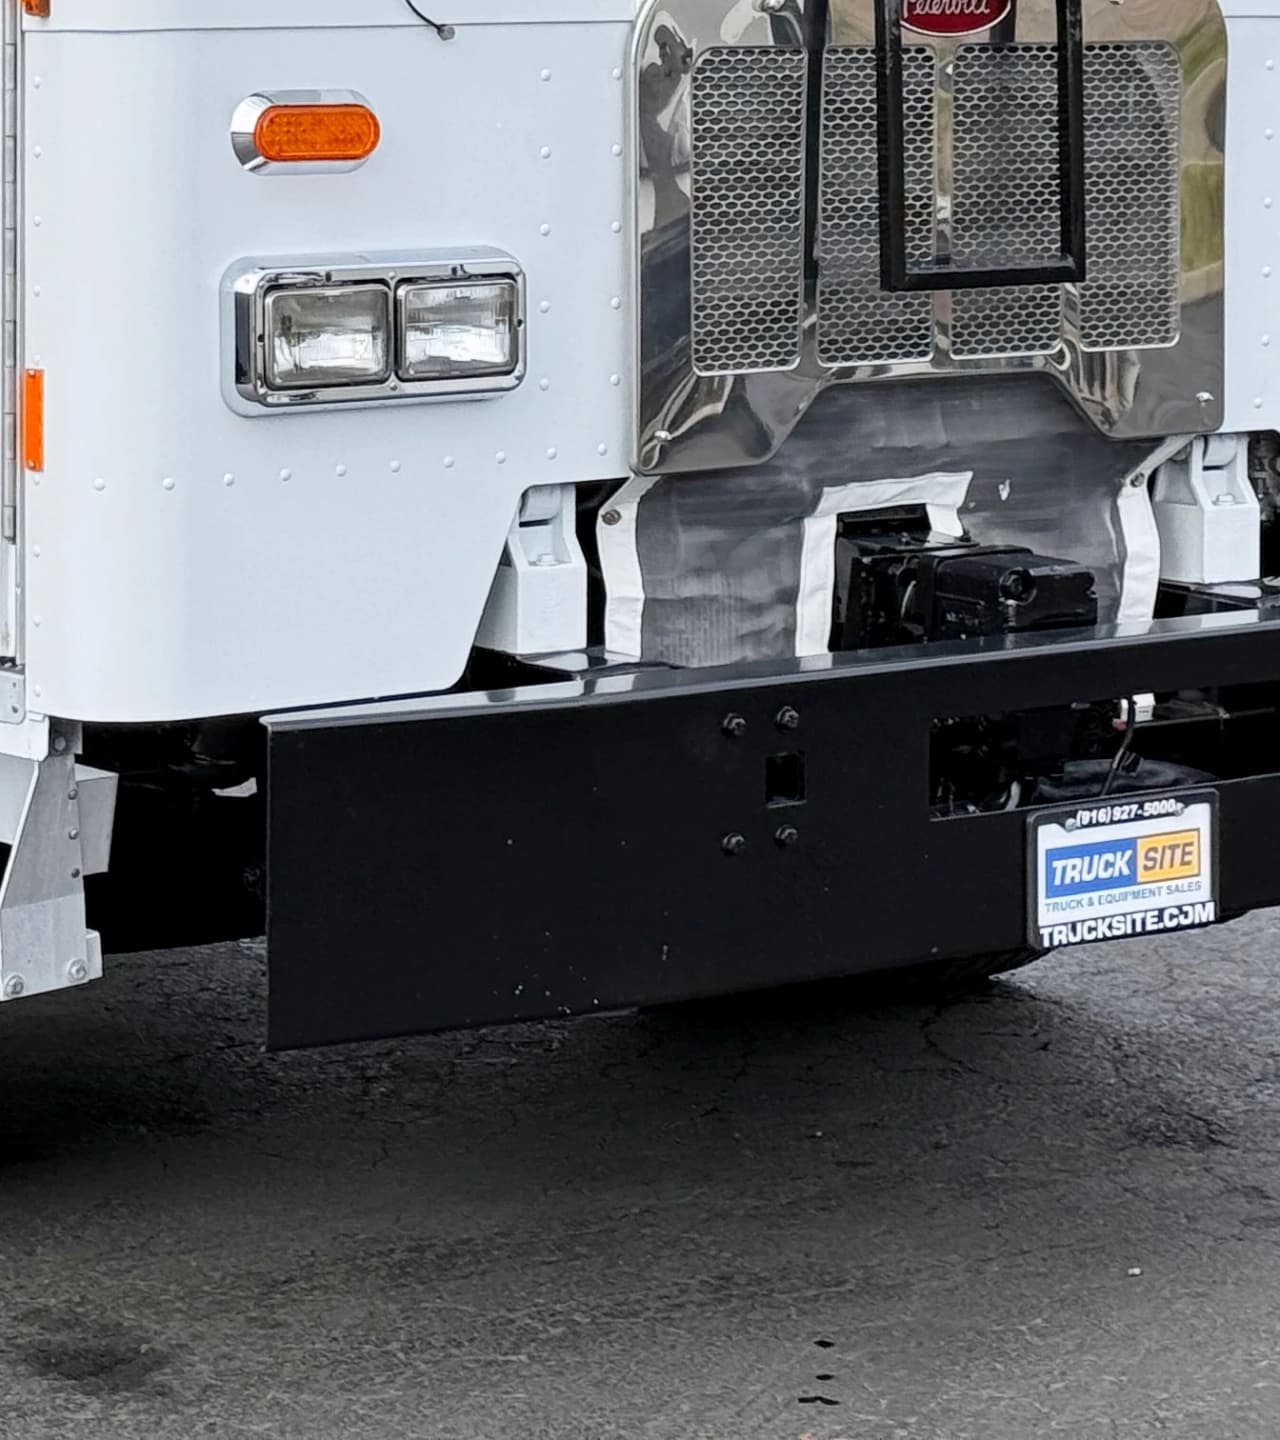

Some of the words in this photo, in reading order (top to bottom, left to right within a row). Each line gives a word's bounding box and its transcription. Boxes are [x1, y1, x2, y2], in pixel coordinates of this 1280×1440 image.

[1052, 849, 1133, 886] TRUCK
[1142, 841, 1195, 873] SITE
[1043, 898, 1084, 913] TRUCK
[1087, 896, 1095, 907] &
[1098, 887, 1163, 906] EQUIPMENT
[1166, 881, 1202, 896] SALES
[1039, 901, 1216, 948] TRUCKSITE.COM
